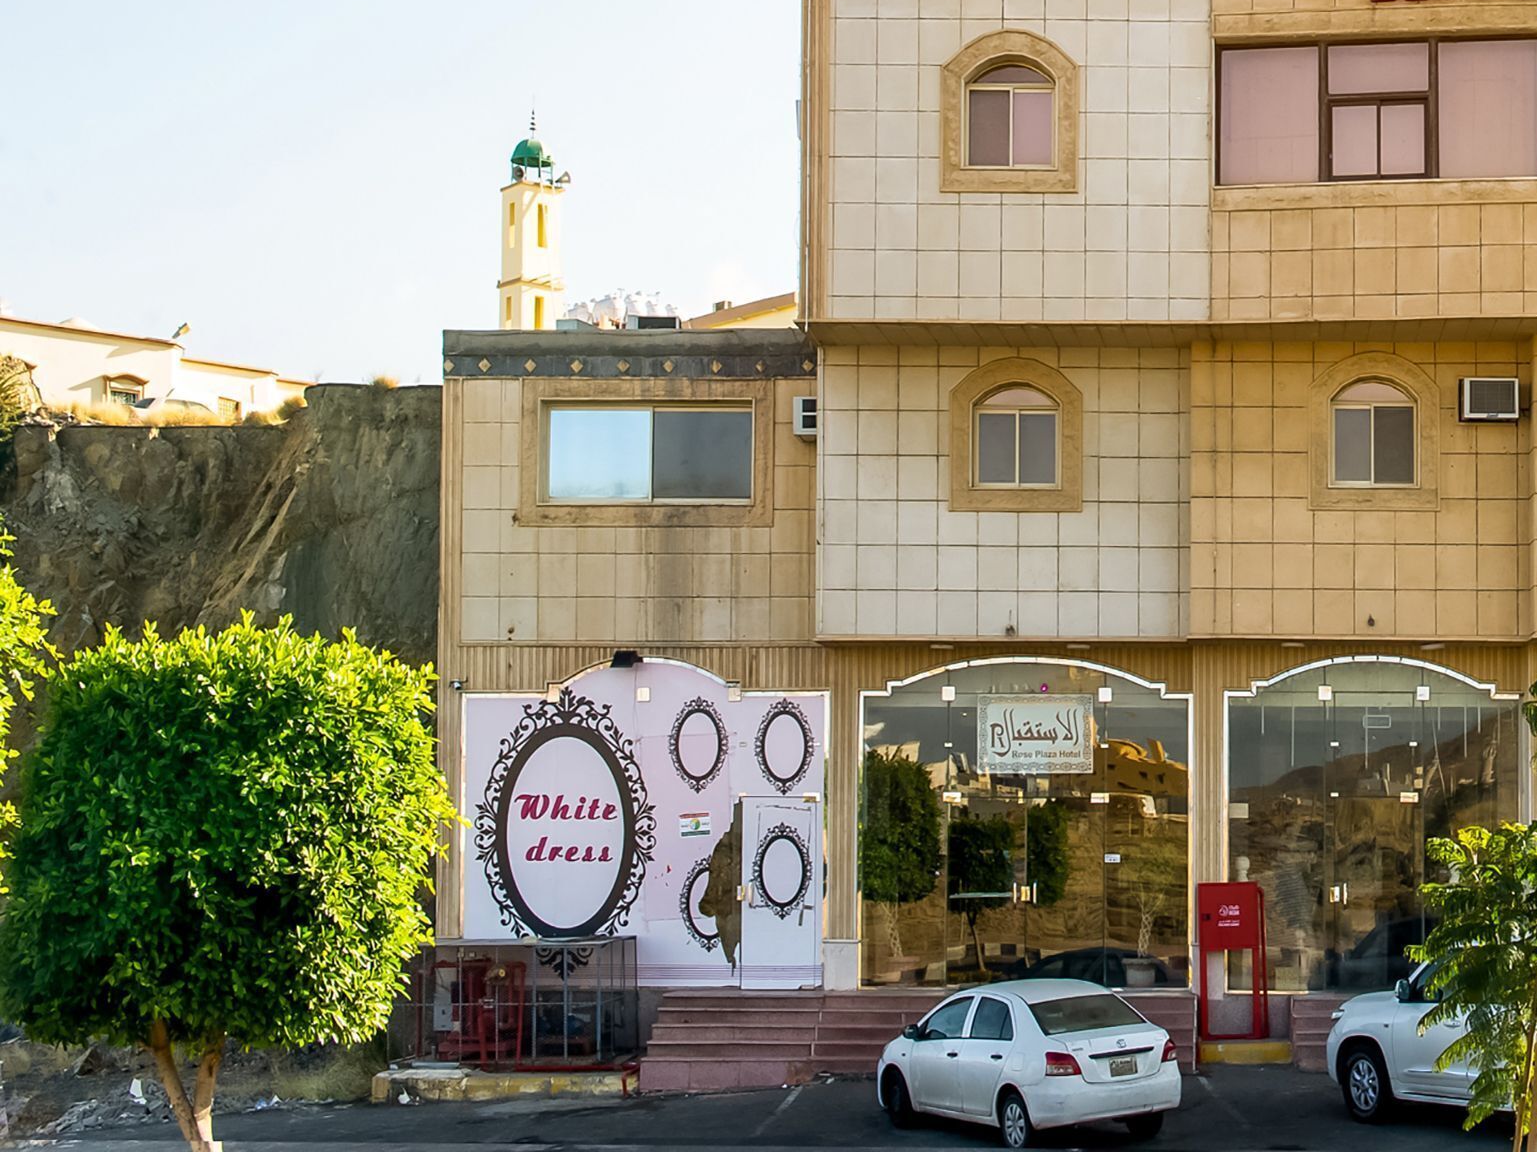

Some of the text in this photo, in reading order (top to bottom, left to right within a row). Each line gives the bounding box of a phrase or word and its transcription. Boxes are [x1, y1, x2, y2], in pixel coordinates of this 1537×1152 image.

[991, 707, 1080, 758] الاستقبال
[1012, 750, 1081, 759] Rose Plaza Hotel
[514, 794, 618, 822] White
[526, 836, 614, 863] dress
